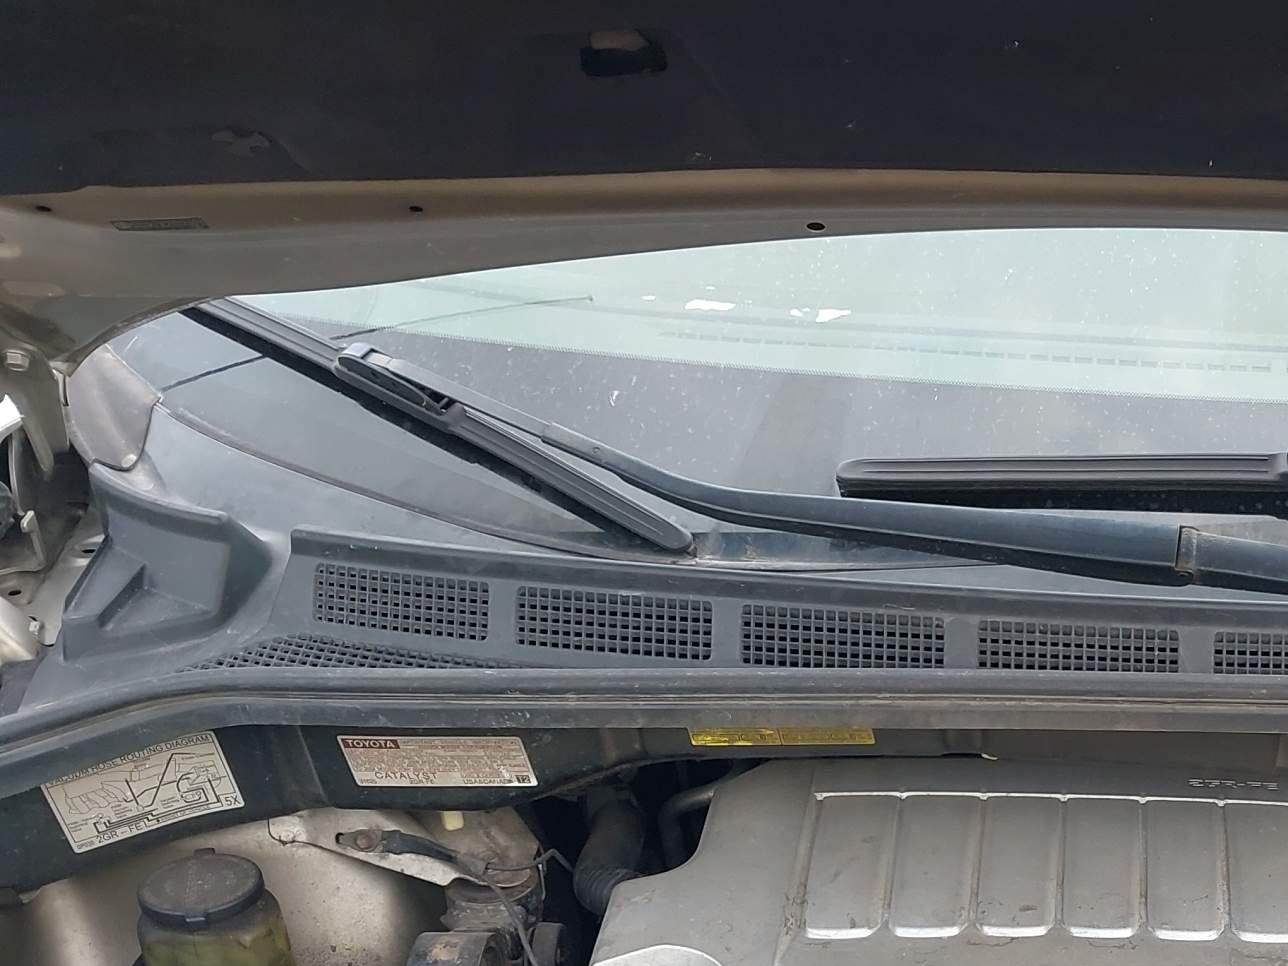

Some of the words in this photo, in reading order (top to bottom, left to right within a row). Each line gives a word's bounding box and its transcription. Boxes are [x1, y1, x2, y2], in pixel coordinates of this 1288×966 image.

[346, 739, 396, 748] TOYOTA
[120, 744, 164, 763] ROUTING
[165, 735, 210, 750] DIAGRAM
[374, 771, 437, 780] CATALYST
[225, 795, 241, 807] 5X
